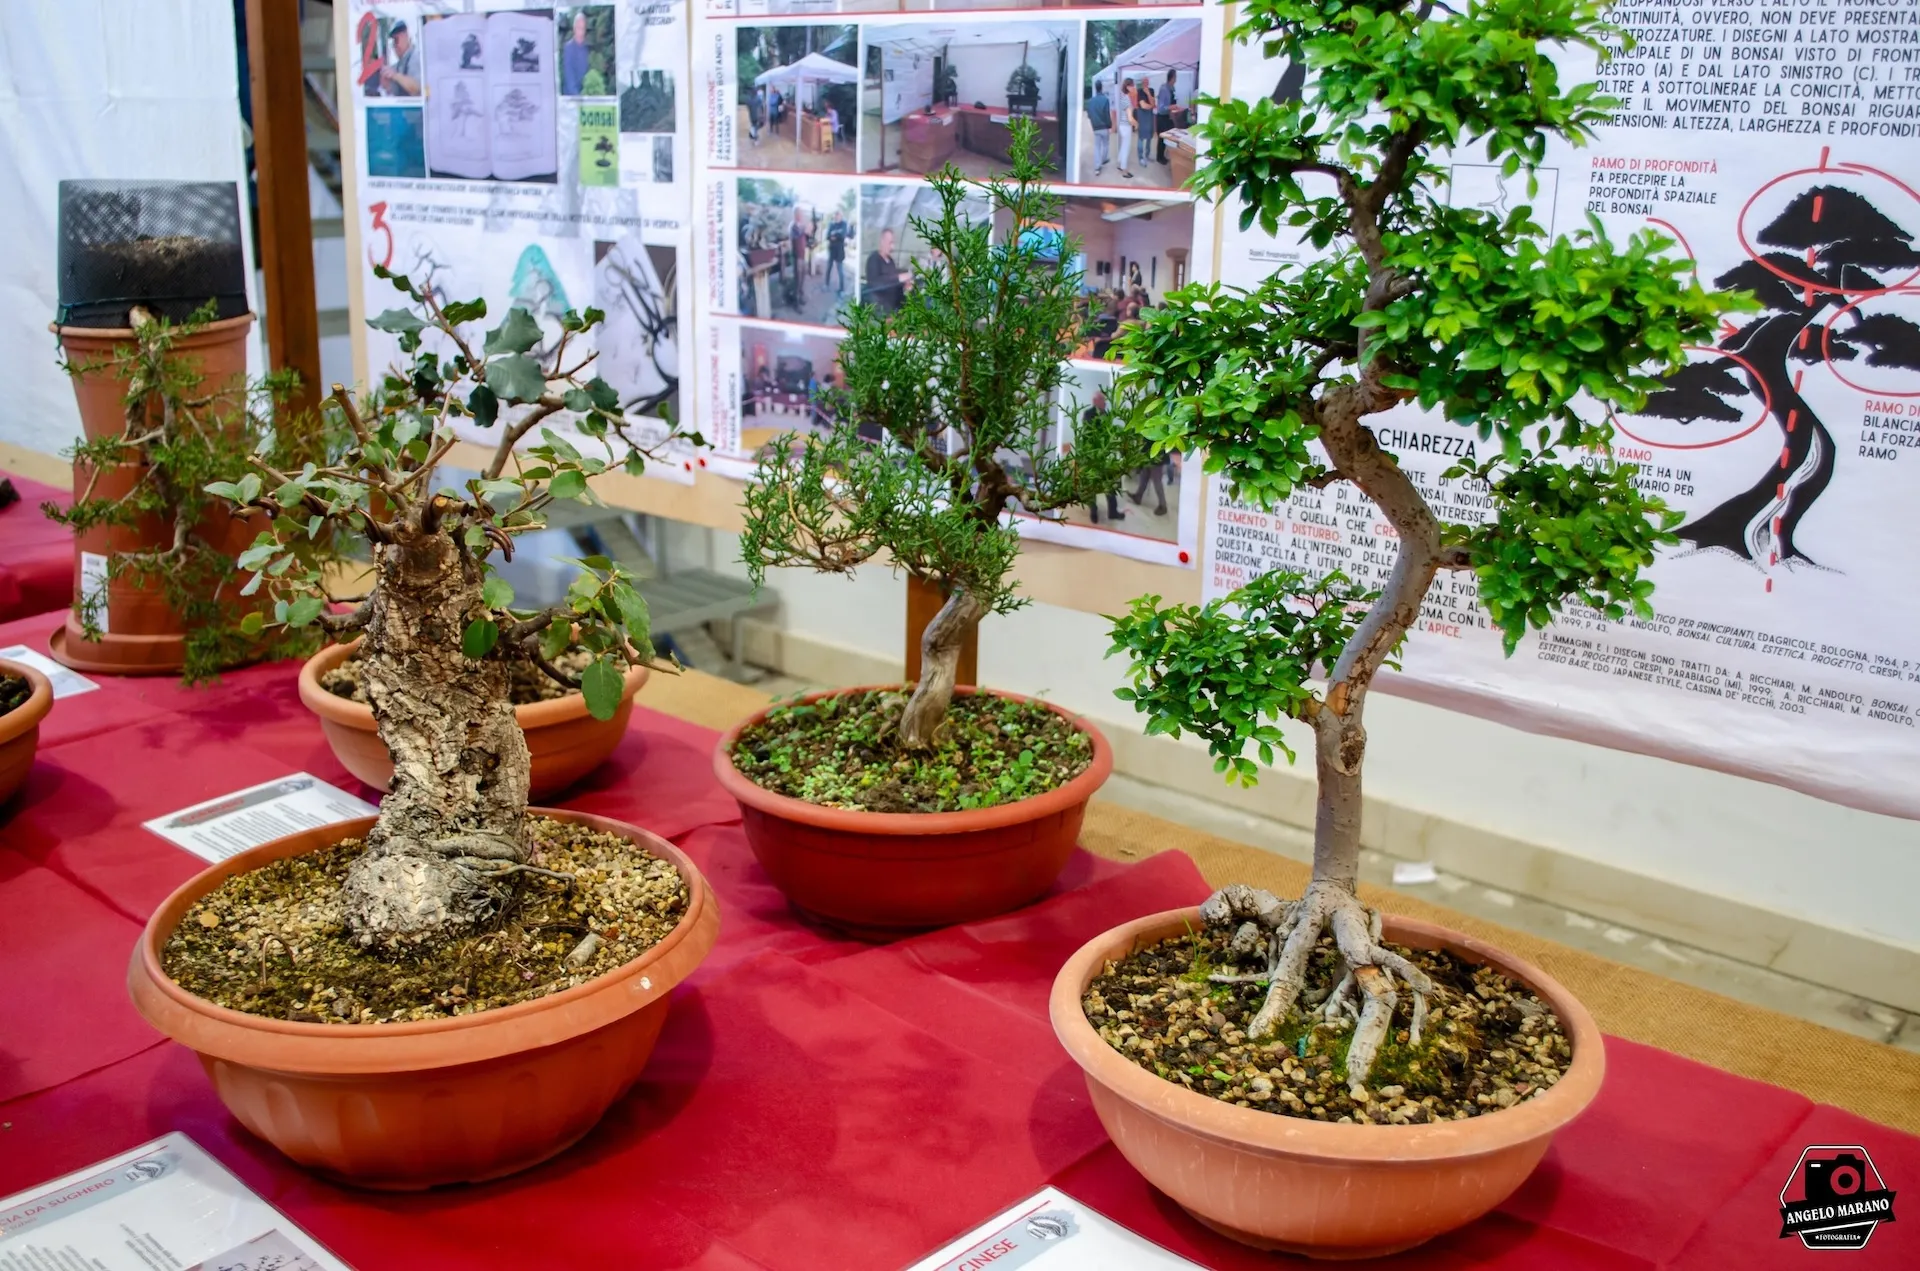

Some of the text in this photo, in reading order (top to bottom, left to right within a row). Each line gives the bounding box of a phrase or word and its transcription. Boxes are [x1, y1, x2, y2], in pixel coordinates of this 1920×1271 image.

[1602, 8, 1920, 27] CONTINUITÀ, OVVERO, NON DEVE PRESENTA
[1722, 29, 1727, 42] I
[1732, 29, 1787, 43] DISEGNI
[1794, 29, 1803, 43] A
[1810, 30, 1849, 43] LATO
[1856, 30, 1919, 44] MOSTRA
[357, 10, 384, 86] 2
[1681, 47, 1693, 60] DI
[1703, 47, 1721, 60] UN
[1731, 47, 1783, 61] BONSAI
[1795, 48, 1836, 61] VISTO
[1847, 48, 1861, 62] DI
[1596, 63, 1645, 77] DESTRO
[1654, 62, 1673, 78] (A)
[1681, 64, 1690, 77] E
[1698, 64, 1723, 78] DAL
[1733, 64, 1771, 79] LATO
[1780, 66, 1843, 80] SINISTRO
[1853, 66, 1878, 82] (C).
[1595, 80, 1634, 94] OLTRE
[1641, 81, 1650, 94] A
[1658, 81, 1757, 96] SOTTOLINERAE
[1764, 83, 1782, 97] LA
[1790, 81, 1865, 101] CONICITÀ,
[580, 106, 616, 127] bonsai
[1643, 98, 1653, 111] IL
[1665, 99, 1751, 114] MOVIMENTO
[1763, 100, 1788, 115] DEL
[1801, 102, 1856, 117] BONSAI
[1590, 115, 1667, 129] DIMENSIONI:
[1673, 117, 1733, 133] ALTEZZA,
[1739, 118, 1821, 134] LARGHEZZA
[1827, 121, 1836, 135] E
[1591, 156, 1718, 174] RAMO DI PROFONDITÀ
[1590, 171, 1685, 188] FA PERCEPIRE LA
[1589, 186, 1717, 205] PROFONDITÀ SPAZIALE
[1588, 201, 1653, 216] DEL BONSAI
[368, 201, 393, 269] 3
[1864, 400, 1904, 415] RAMO
[1378, 428, 1477, 459] CHIAREZZA
[1860, 430, 1920, 448] LA FORZA
[1618, 446, 1653, 462] RAMO
[1858, 445, 1898, 461] RAMO
[1656, 466, 1671, 479] HA
[1675, 469, 1692, 482] UN
[1337, 488, 1348, 500] DI
[1673, 484, 1695, 497] PER
[1292, 495, 1375, 521] DELLA PIANTA.
[1217, 509, 1267, 528] ELEMENTO
[1274, 520, 1284, 533] DI
[1350, 534, 1377, 550] RAMI
[1287, 506, 1293, 519] È
[1300, 511, 1338, 528] QUELLA
[1346, 519, 1367, 533] CHE
[1217, 523, 1393, 567] TRASVERSALI, ALL'INTERNO DELLE
[1216, 536, 1253, 553] QUESTA
[1261, 545, 1297, 562] SCELTA
[1304, 552, 1310, 565] È
[1317, 556, 1344, 571] UTILE
[1350, 562, 1369, 576] PER
[1431, 579, 1443, 591] IN
[1215, 550, 1262, 568] DIREZIONE
[1422, 593, 1458, 609] RAZIE
[1214, 563, 1246, 581] RAMO,
[1418, 606, 1444, 621] OMA
[1448, 611, 1474, 626] CON
[1477, 617, 1486, 629] IL
[1213, 577, 1223, 588] DI
[1418, 619, 1463, 639] L'APICE.
[1560, 615, 1584, 630] 1999,
[1585, 623, 1594, 632] P.
[1596, 623, 1609, 634] 43.
[1630, 619, 1672, 636] ANDOLFO,
[1676, 628, 1711, 642] BONSAI.
[1715, 635, 1757, 652] CULTURA.
[1761, 644, 1806, 661] ESTETICA.
[1811, 653, 1864, 673] PROGETTO,
[1868, 665, 1903, 681] CRESPI,
[1677, 617, 1911, 670] PER PRINCIPIANTI, EDAGRICOLE, BOLOGNA, 1964, P.
[1537, 651, 1807, 715] CORSO BASE, EDO JAPANESE STYLE, CASSINA DE' PECCHI, 2003.
[1538, 631, 1548, 641] LE
[1552, 634, 1593, 650] IMMAGINI
[1596, 643, 1602, 652] E
[1613, 646, 1647, 661] DISEGNI
[1651, 653, 1675, 667] SONO
[1681, 659, 1711, 674] TRATTI
[1715, 666, 1731, 677] DA:
[1735, 671, 1744, 681] A.
[1749, 673, 1796, 692] RICCHIARI,
[1801, 684, 1812, 695] M.
[1818, 688, 1865, 706] ANDOLFO,
[1871, 698, 1909, 715] BONSAI.
[1538, 641, 1577, 658] ESTETICA.
[1581, 650, 1628, 668] PROGETTO,
[1632, 660, 1663, 676] CRESPI,
[1667, 667, 1720, 686] PARABIAGO
[1724, 678, 1743, 693] (MI),
[1783, 692, 1793, 702] A.
[1797, 694, 1846, 714] RICCHIARI,
[1850, 705, 1862, 716] M.
[1867, 709, 1915, 728] ANDOLFO,
[24, 1205, 46, 1217] DA
[48, 1178, 116, 1208] SUGHERO
[957, 1238, 1019, 1271] CINESE
